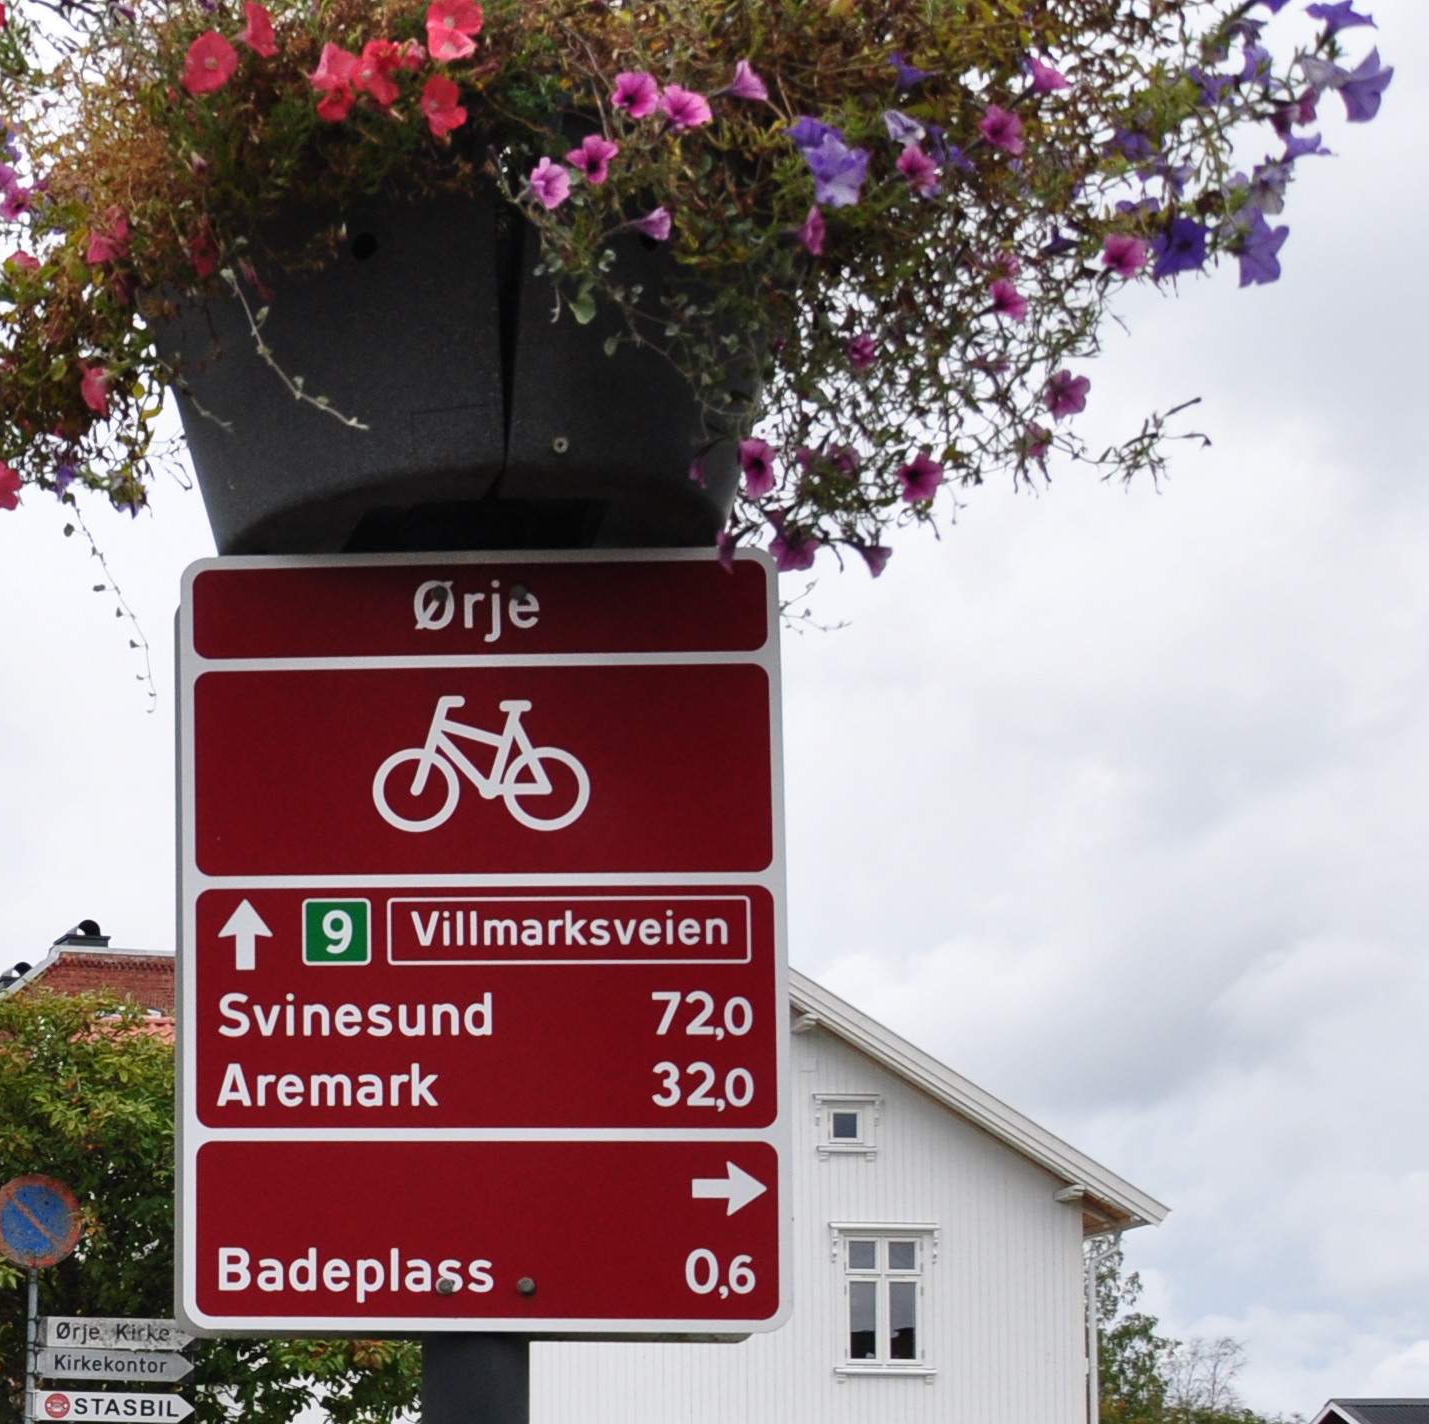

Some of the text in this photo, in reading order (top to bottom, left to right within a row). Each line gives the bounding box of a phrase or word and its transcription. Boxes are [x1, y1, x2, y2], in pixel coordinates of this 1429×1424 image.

[413, 580, 541, 643] Ørje
[322, 910, 353, 954] 9
[411, 909, 729, 947] Villmarksveien
[218, 991, 754, 1041] Svinesund 72,0
[217, 1062, 755, 1113] Aremark 32,0
[218, 1246, 757, 1304] Badeplass 0,6
[56, 1321, 170, 1345] Ørje Kirke
[54, 1354, 168, 1374] Kirkekontor
[74, 1397, 179, 1418] STASBIL
